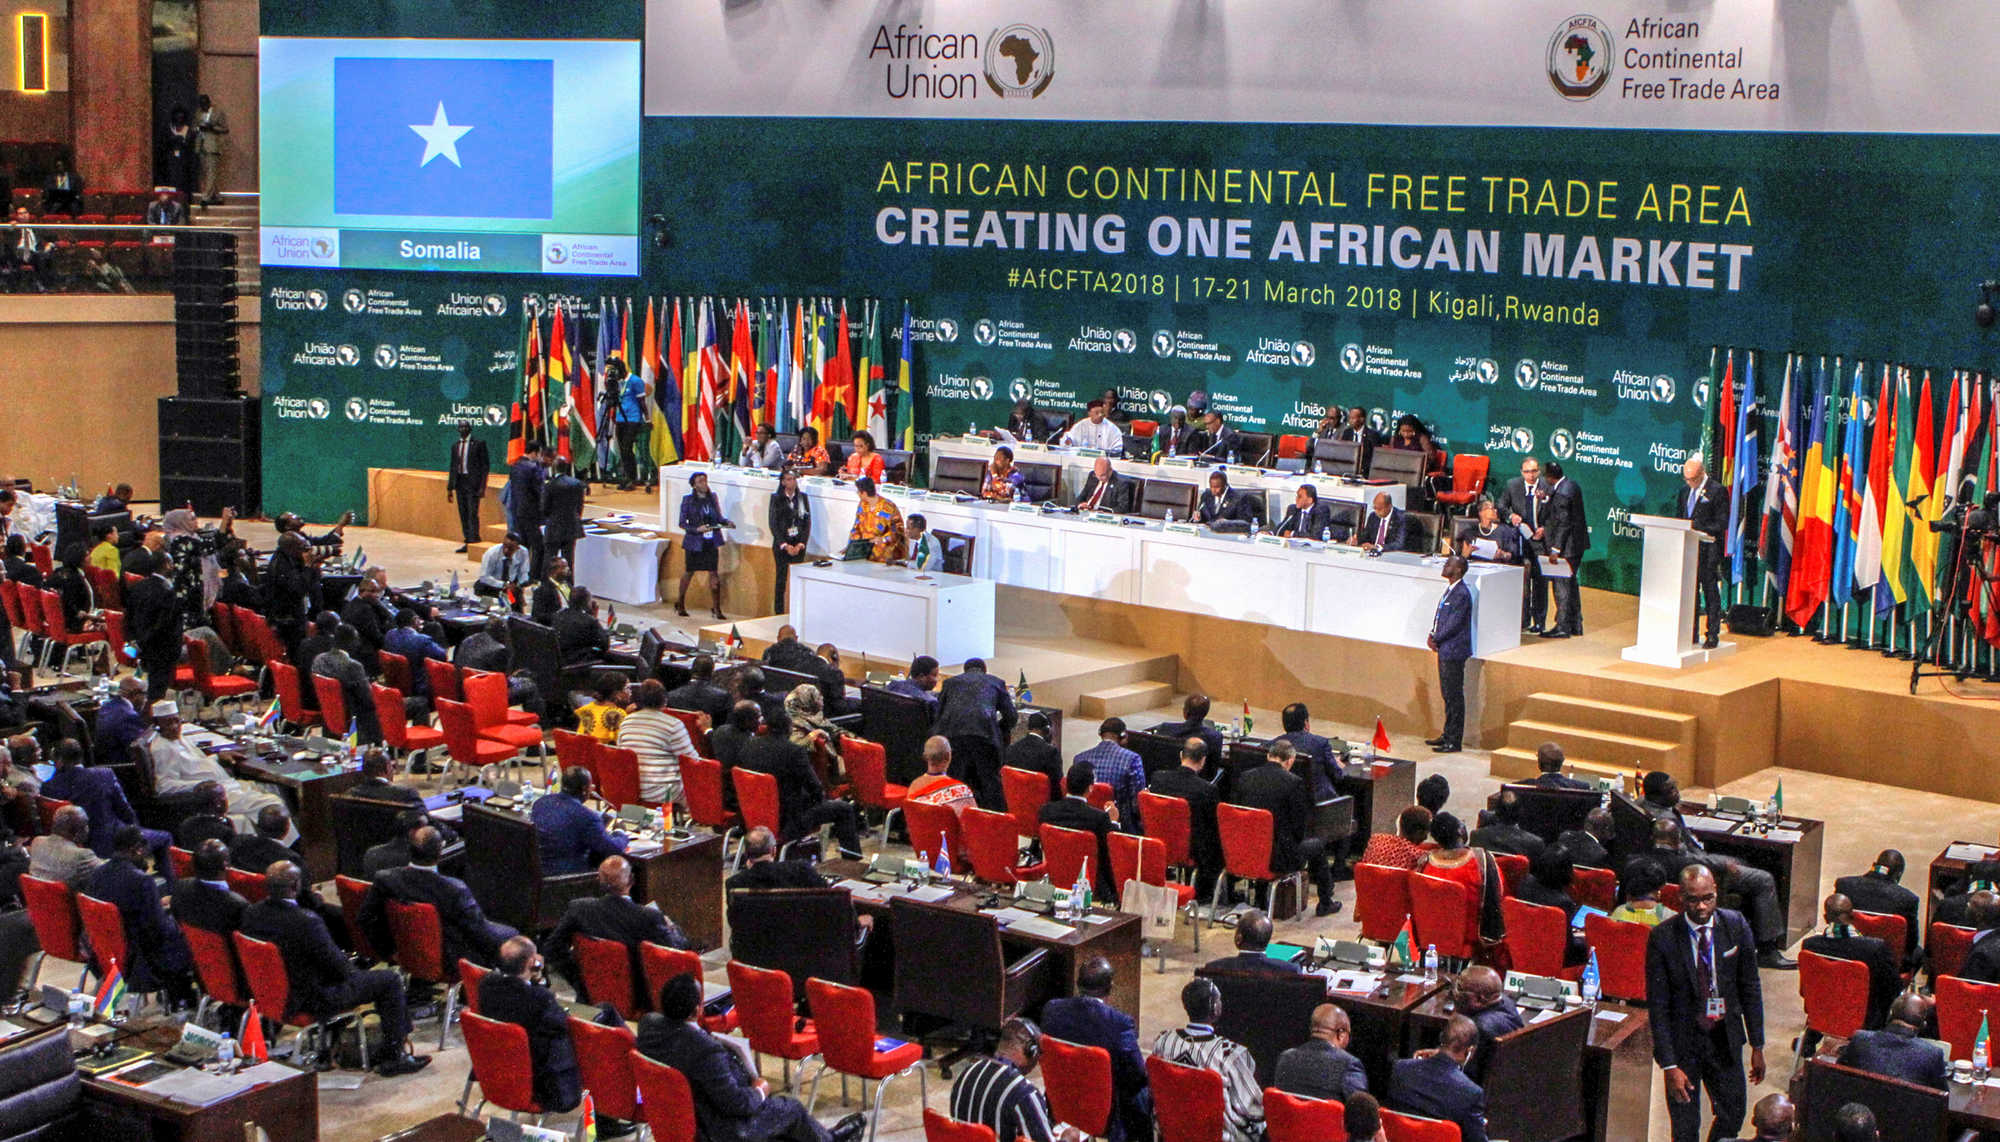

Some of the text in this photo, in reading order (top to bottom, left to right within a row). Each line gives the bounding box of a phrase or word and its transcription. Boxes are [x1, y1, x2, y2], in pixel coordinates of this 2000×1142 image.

[1626, 18, 1699, 40] African
[869, 25, 978, 60] African
[1623, 47, 1744, 72] Continental
[886, 64, 977, 99] Union
[1622, 78, 1781, 101] Free Trade Area
[876, 161, 1752, 227] AFRICAN CONTINENTAL FREE TRADE AREA
[271, 235, 309, 246] African
[278, 247, 310, 259] Union
[400, 239, 481, 260] Somalia
[875, 207, 1753, 291] CREATING ONE AFRICAN MARKET
[270, 288, 305, 299] African
[1008, 267, 1165, 296] #AfCFTA2018
[1191, 276, 1251, 302] 17-21
[1265, 279, 1336, 306] March
[1347, 285, 1401, 311] 2018
[276, 299, 305, 310] Union
[451, 293, 483, 305] Union
[437, 304, 483, 316] Africaine
[999, 320, 1024, 329] African
[891, 328, 935, 342] Afcaine
[999, 330, 1040, 339] Continental
[1081, 326, 1112, 340] União
[1177, 330, 1203, 339] African
[305, 342, 336, 354] União
[400, 345, 426, 353] African
[999, 339, 1053, 349] Free Trade Area
[1068, 338, 1112, 352] Africana
[1177, 341, 1218, 351] Continental
[1259, 337, 1290, 352] União
[1366, 345, 1393, 355] African
[293, 354, 336, 366] Africana
[400, 354, 441, 362] Continental
[1177, 351, 1231, 362] Free Trade Area
[1246, 350, 1290, 365] Africana
[1366, 355, 1409, 367] Continental
[1541, 361, 1568, 371] African
[1366, 366, 1422, 379] Free Trade Area
[1540, 371, 1584, 384] Continental
[1612, 370, 1650, 386] African
[939, 373, 970, 387] Union
[1034, 379, 1060, 388] African
[926, 385, 970, 399] Africaine
[1034, 388, 1075, 398] Continental
[1117, 386, 1148, 400] União
[1540, 383, 1598, 397] Free Trade Area
[1618, 385, 1650, 401] Union
[273, 396, 307, 407] African
[1212, 392, 1238, 401] African
[369, 399, 395, 407] African
[452, 403, 483, 415] Union
[1034, 398, 1050, 406] Free
[1050, 399, 1071, 408] Trade
[1116, 401, 1148, 414] ricana
[1212, 402, 1253, 413] Continental
[1295, 401, 1326, 417] União
[278, 407, 307, 418] Union
[369, 408, 410, 416] Continental
[1228, 415, 1248, 423] Trade
[1248, 416, 1266, 425] Area
[1281, 413, 1319, 429] African
[1576, 431, 1604, 442] African
[1575, 442, 1620, 455] Continental
[1649, 443, 1687, 460] African
[1575, 453, 1633, 469] Free Trade Area
[1607, 506, 1632, 522] Afric
[1612, 522, 1643, 538] Union
